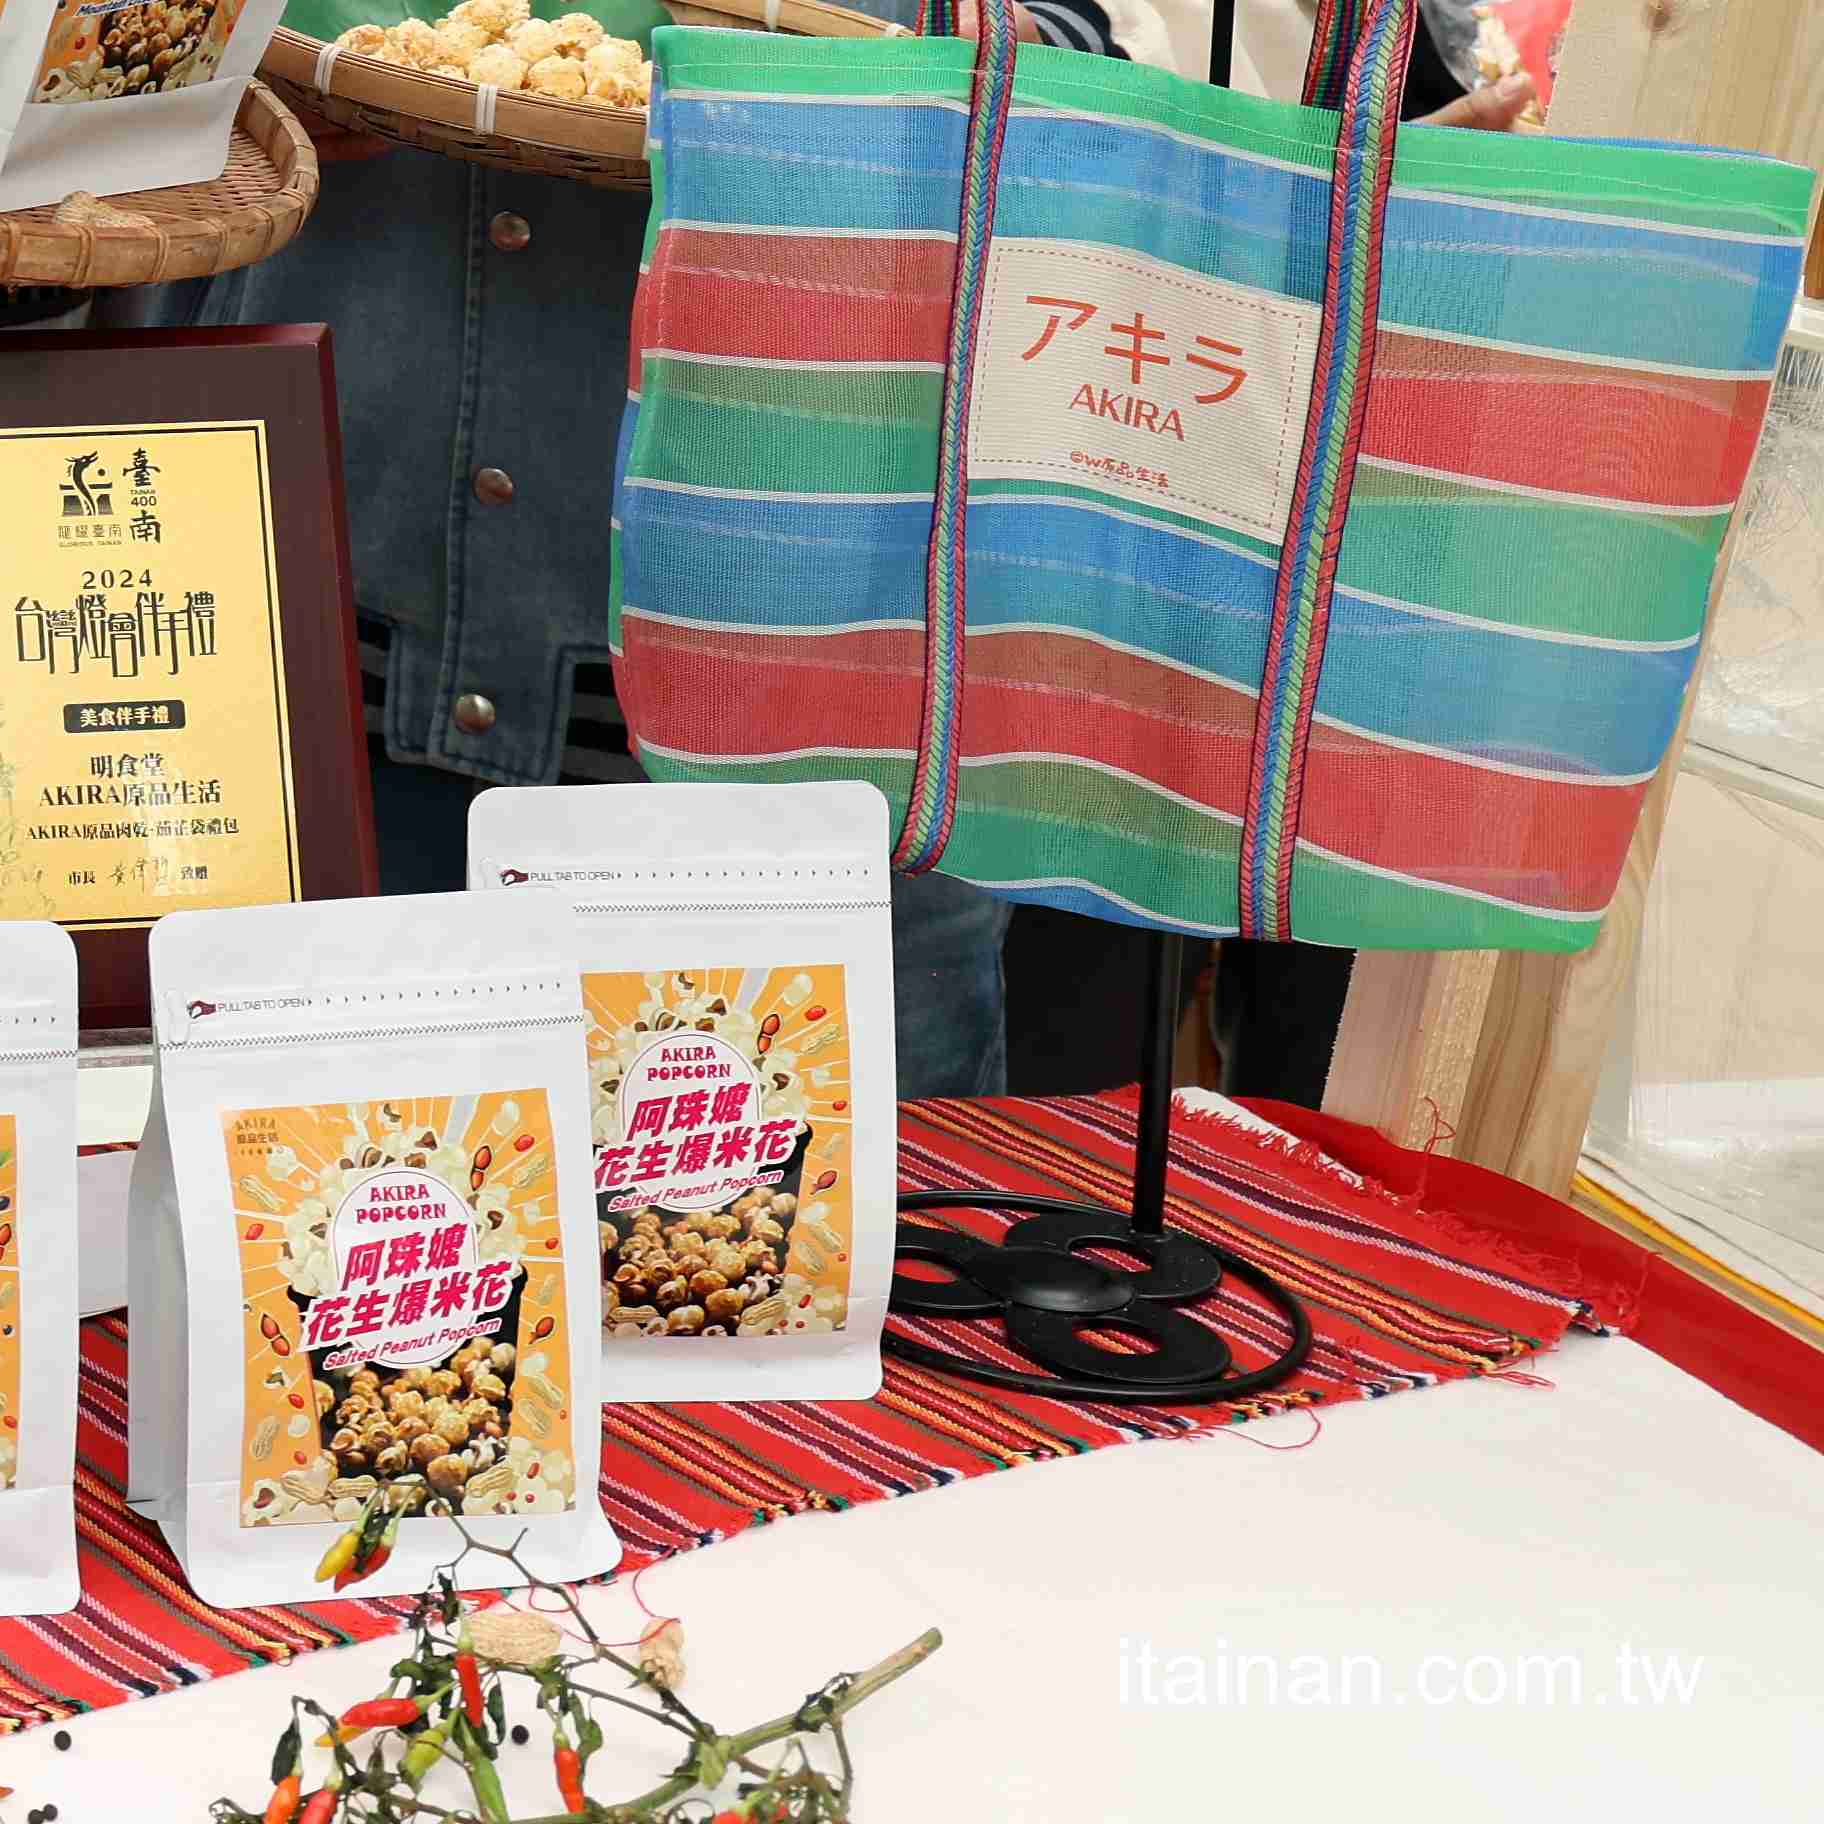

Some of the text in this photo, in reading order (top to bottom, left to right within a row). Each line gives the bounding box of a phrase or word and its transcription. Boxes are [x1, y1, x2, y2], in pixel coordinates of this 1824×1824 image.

[1021, 294, 1248, 404] アキラ
[1068, 383, 1185, 442] AKIRA
[131, 496, 156, 506] 400
[82, 569, 152, 589] 2024
[80, 706, 170, 728] 美食伴手禮
[90, 752, 164, 778] 明食堂
[39, 779, 221, 807] AKIRA原品生活
[67, 871, 96, 885] 市長
[661, 1046, 717, 1061] AKIRA
[647, 1064, 731, 1081] POPCORN
[627, 1082, 752, 1141] 阿珠嬤
[594, 1119, 798, 1189] 花生爆米花
[370, 1184, 430, 1203] AKIRA
[609, 1171, 782, 1211] Salted Peanut Popcorn
[356, 1203, 447, 1224] POPCORN
[341, 1224, 469, 1292] 阿珠嬤
[306, 1260, 513, 1345] 花生爆米花
[325, 1318, 501, 1369] Salted Peanut Popcorn
